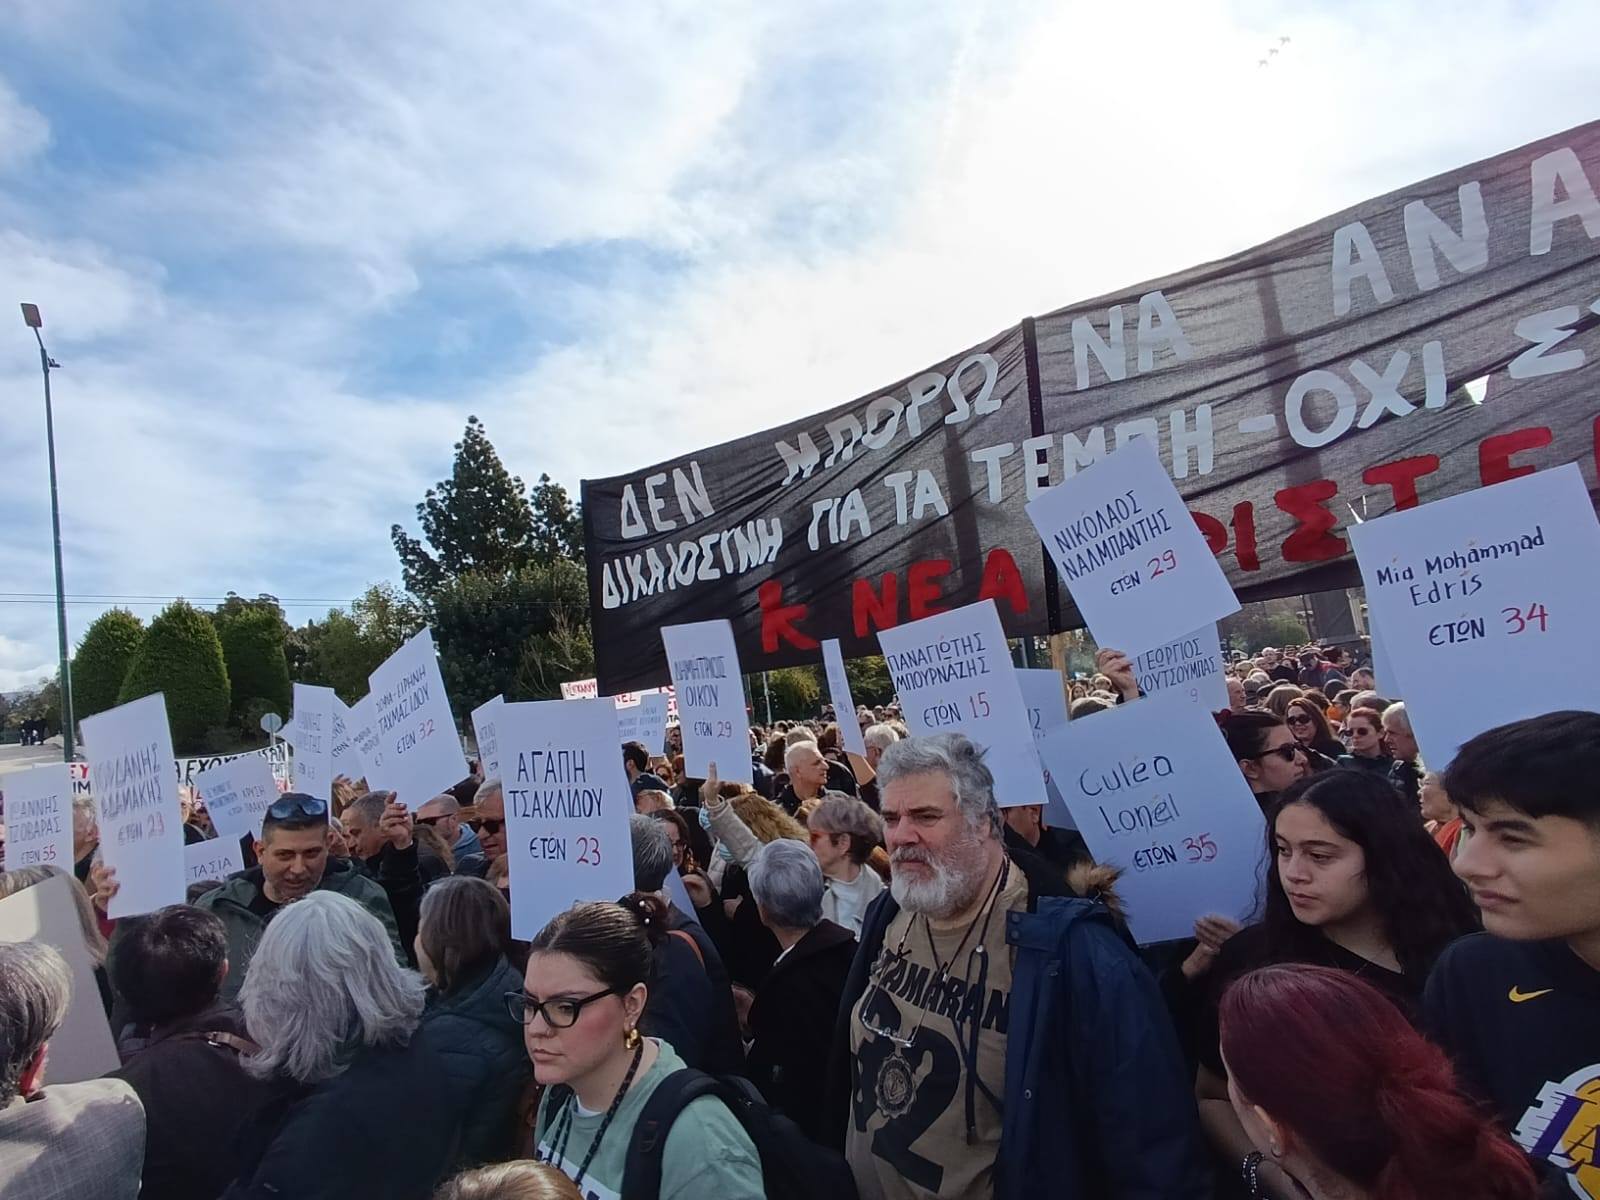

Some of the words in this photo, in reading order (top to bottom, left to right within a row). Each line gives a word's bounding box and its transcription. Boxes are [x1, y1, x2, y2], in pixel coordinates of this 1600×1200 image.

[620, 461, 715, 538] ΔΕΝ
[775, 353, 1002, 486] ΜΠΟΡΩ
[1071, 290, 1195, 390] ΝΑ
[808, 488, 872, 551] ΓΙΑ
[884, 469, 949, 525] ΤΑ
[1146, 549, 1177, 580] 29
[852, 548, 1030, 639] ΝΕΑ
[1501, 603, 1549, 635] 34
[969, 691, 990, 719] 15
[418, 718, 436, 741] 32
[717, 721, 732, 738] 29
[576, 837, 601, 866] 23
[1181, 832, 1219, 864] 35
